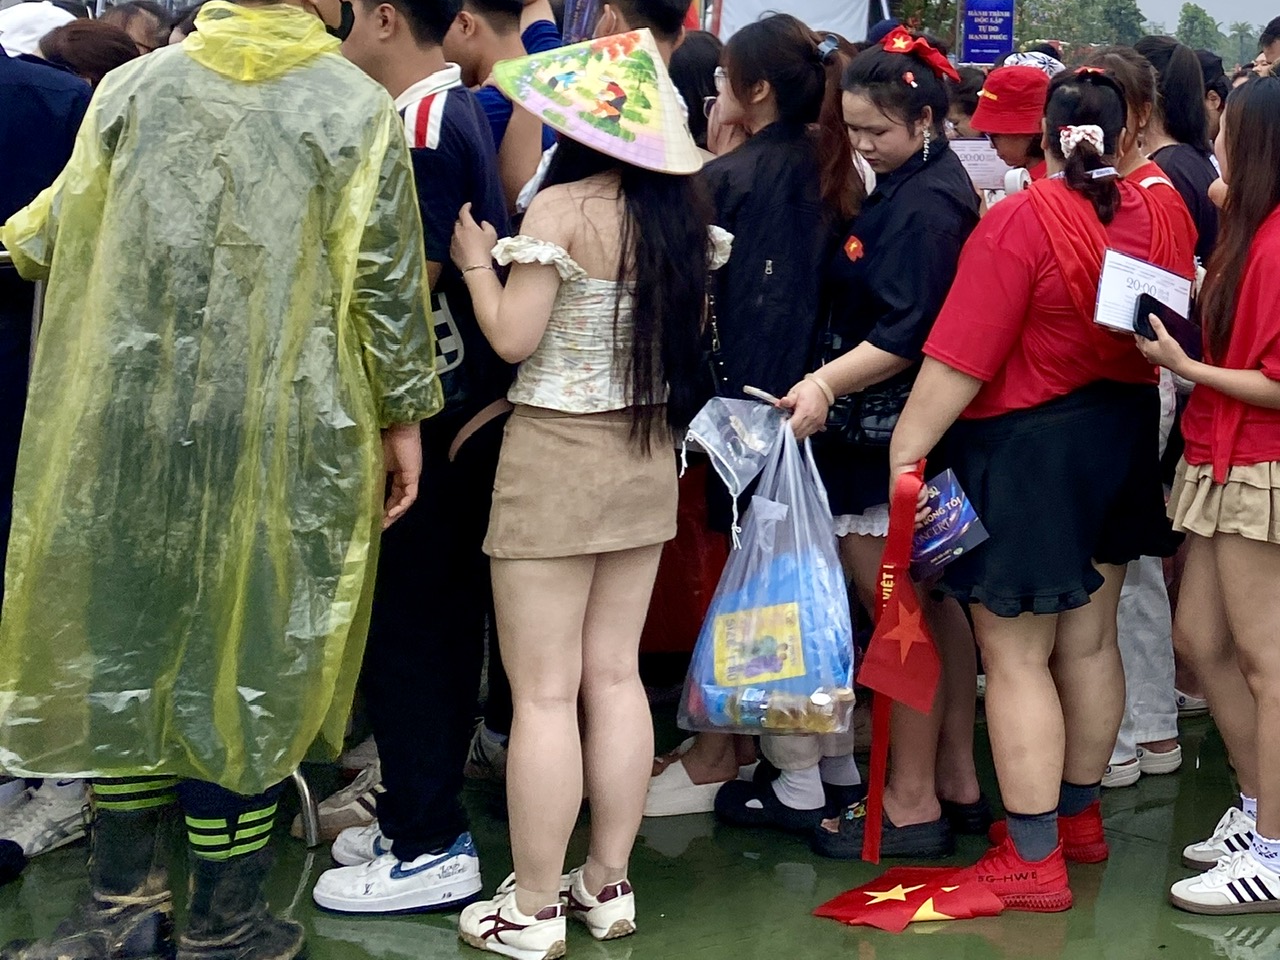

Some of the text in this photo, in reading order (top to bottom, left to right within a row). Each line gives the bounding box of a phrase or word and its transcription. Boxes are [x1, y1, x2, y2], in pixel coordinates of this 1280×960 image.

[1126, 277, 1157, 297] 20:00
[922, 507, 946, 527] RONG
[880, 572, 895, 600] VIỆT
